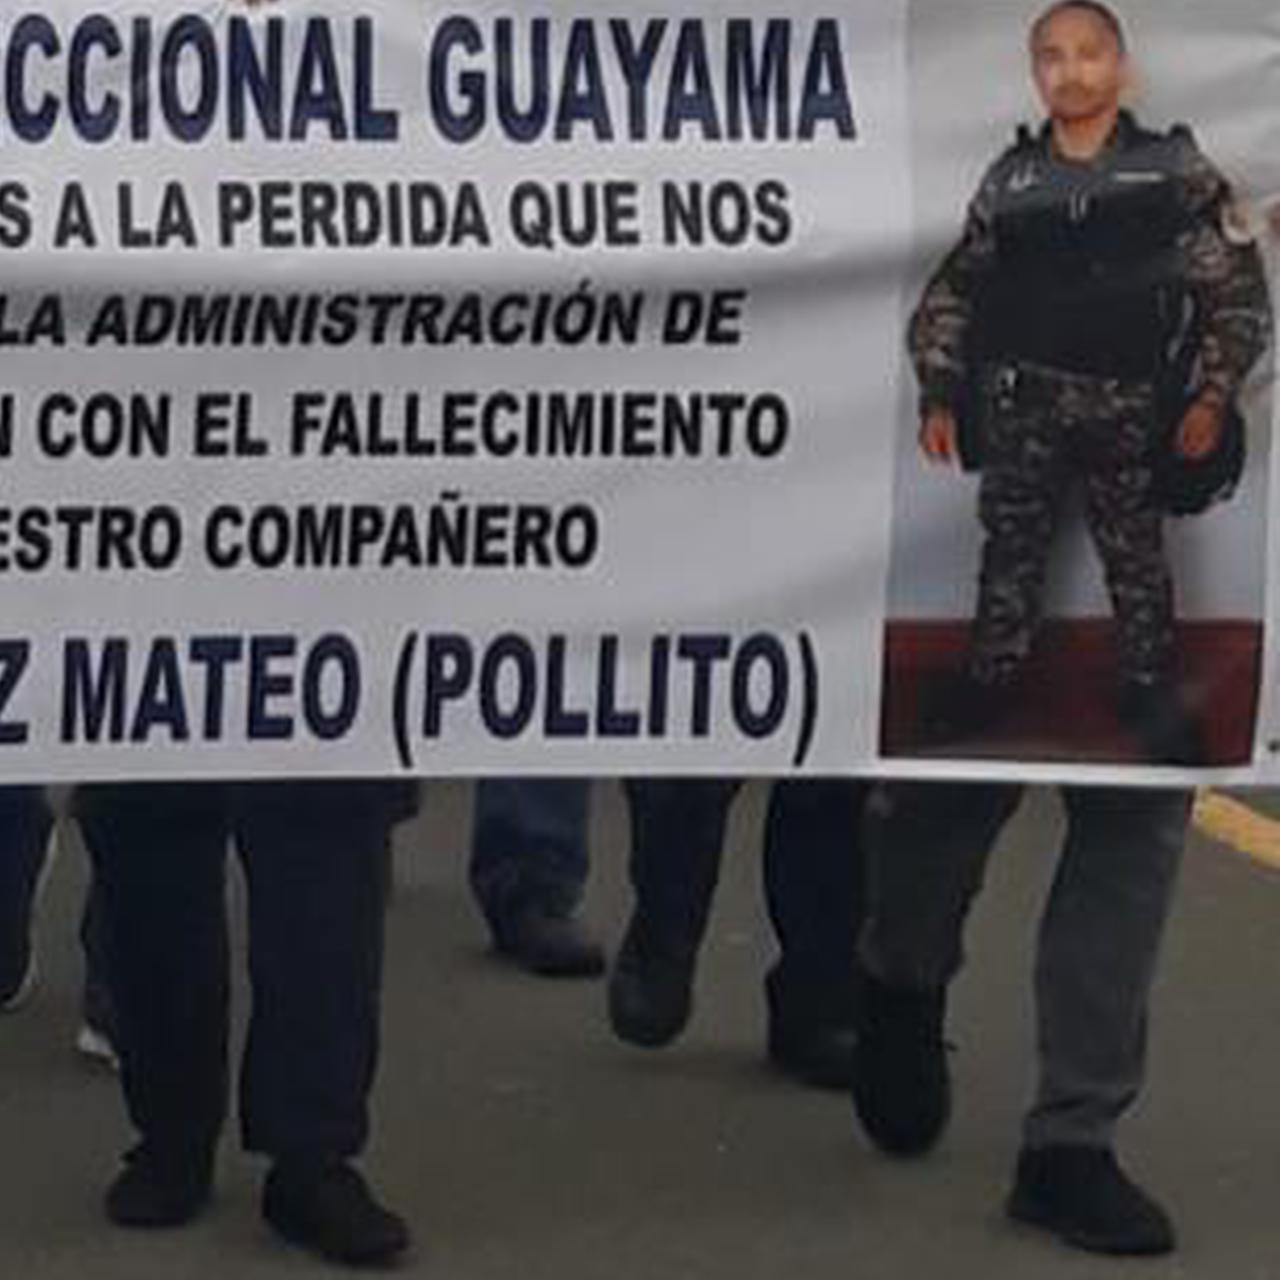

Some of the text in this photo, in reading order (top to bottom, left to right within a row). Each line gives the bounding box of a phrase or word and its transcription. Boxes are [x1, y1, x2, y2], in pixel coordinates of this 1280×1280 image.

[428, 13, 857, 144] GUAYAMA
[53, 181, 98, 248] A
[118, 181, 198, 248] LA
[218, 180, 491, 248] PERDIDA
[509, 180, 641, 250] QUE
[661, 179, 792, 247] NOS
[85, 279, 646, 347] ADMINISTRACIÓN
[661, 287, 748, 346] DE
[36, 391, 172, 458] CON
[193, 391, 269, 458] EL
[289, 390, 790, 458] FALLECIMIENTO
[203, 490, 599, 569] COMPAÑERO
[59, 632, 362, 744] MATEO
[392, 630, 819, 769] (POLLITO)
